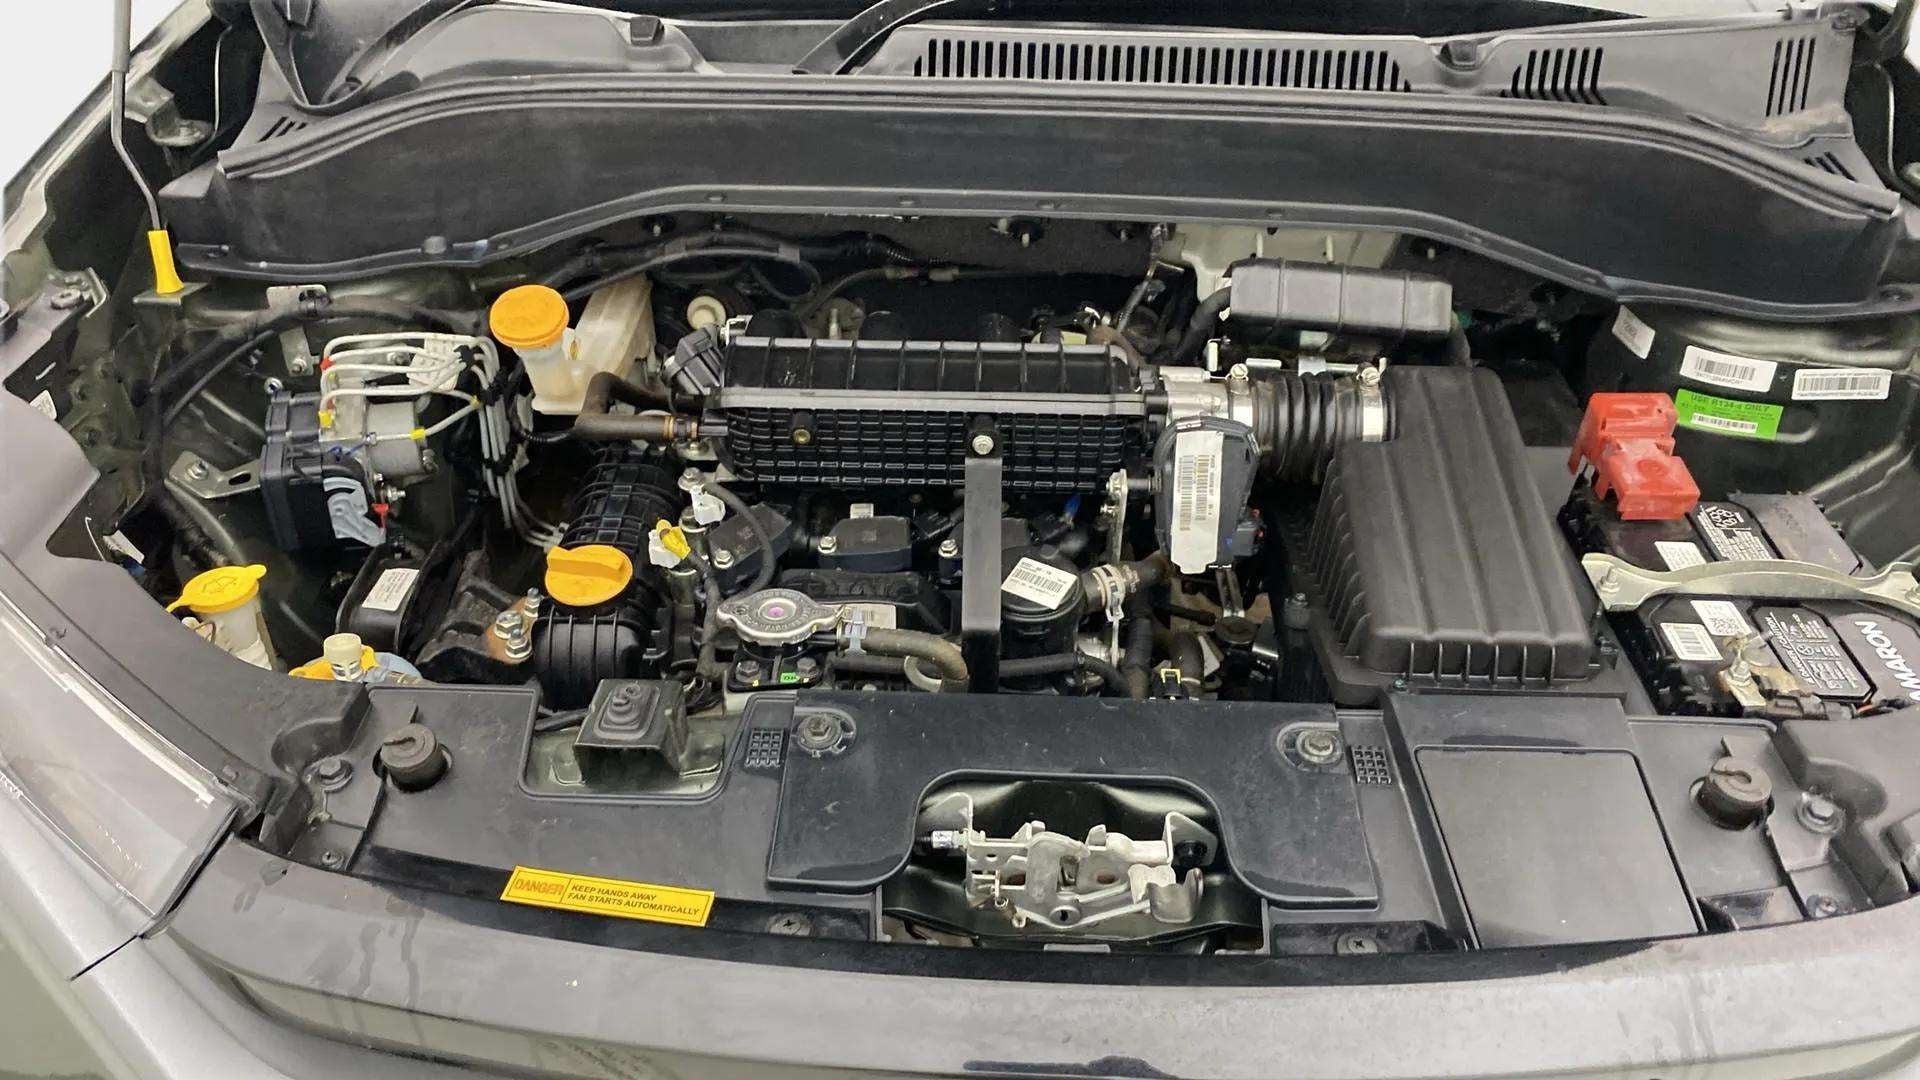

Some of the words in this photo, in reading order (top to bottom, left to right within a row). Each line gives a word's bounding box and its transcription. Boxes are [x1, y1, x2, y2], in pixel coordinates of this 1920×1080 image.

[514, 878, 565, 896] DANGER
[571, 883, 598, 893] KEEP
[598, 887, 630, 898] HANDS
[630, 891, 657, 901] AWAY
[567, 892, 587, 901] FAN
[588, 895, 624, 906] STARTS
[624, 900, 700, 916] AUTOMATICALLY
